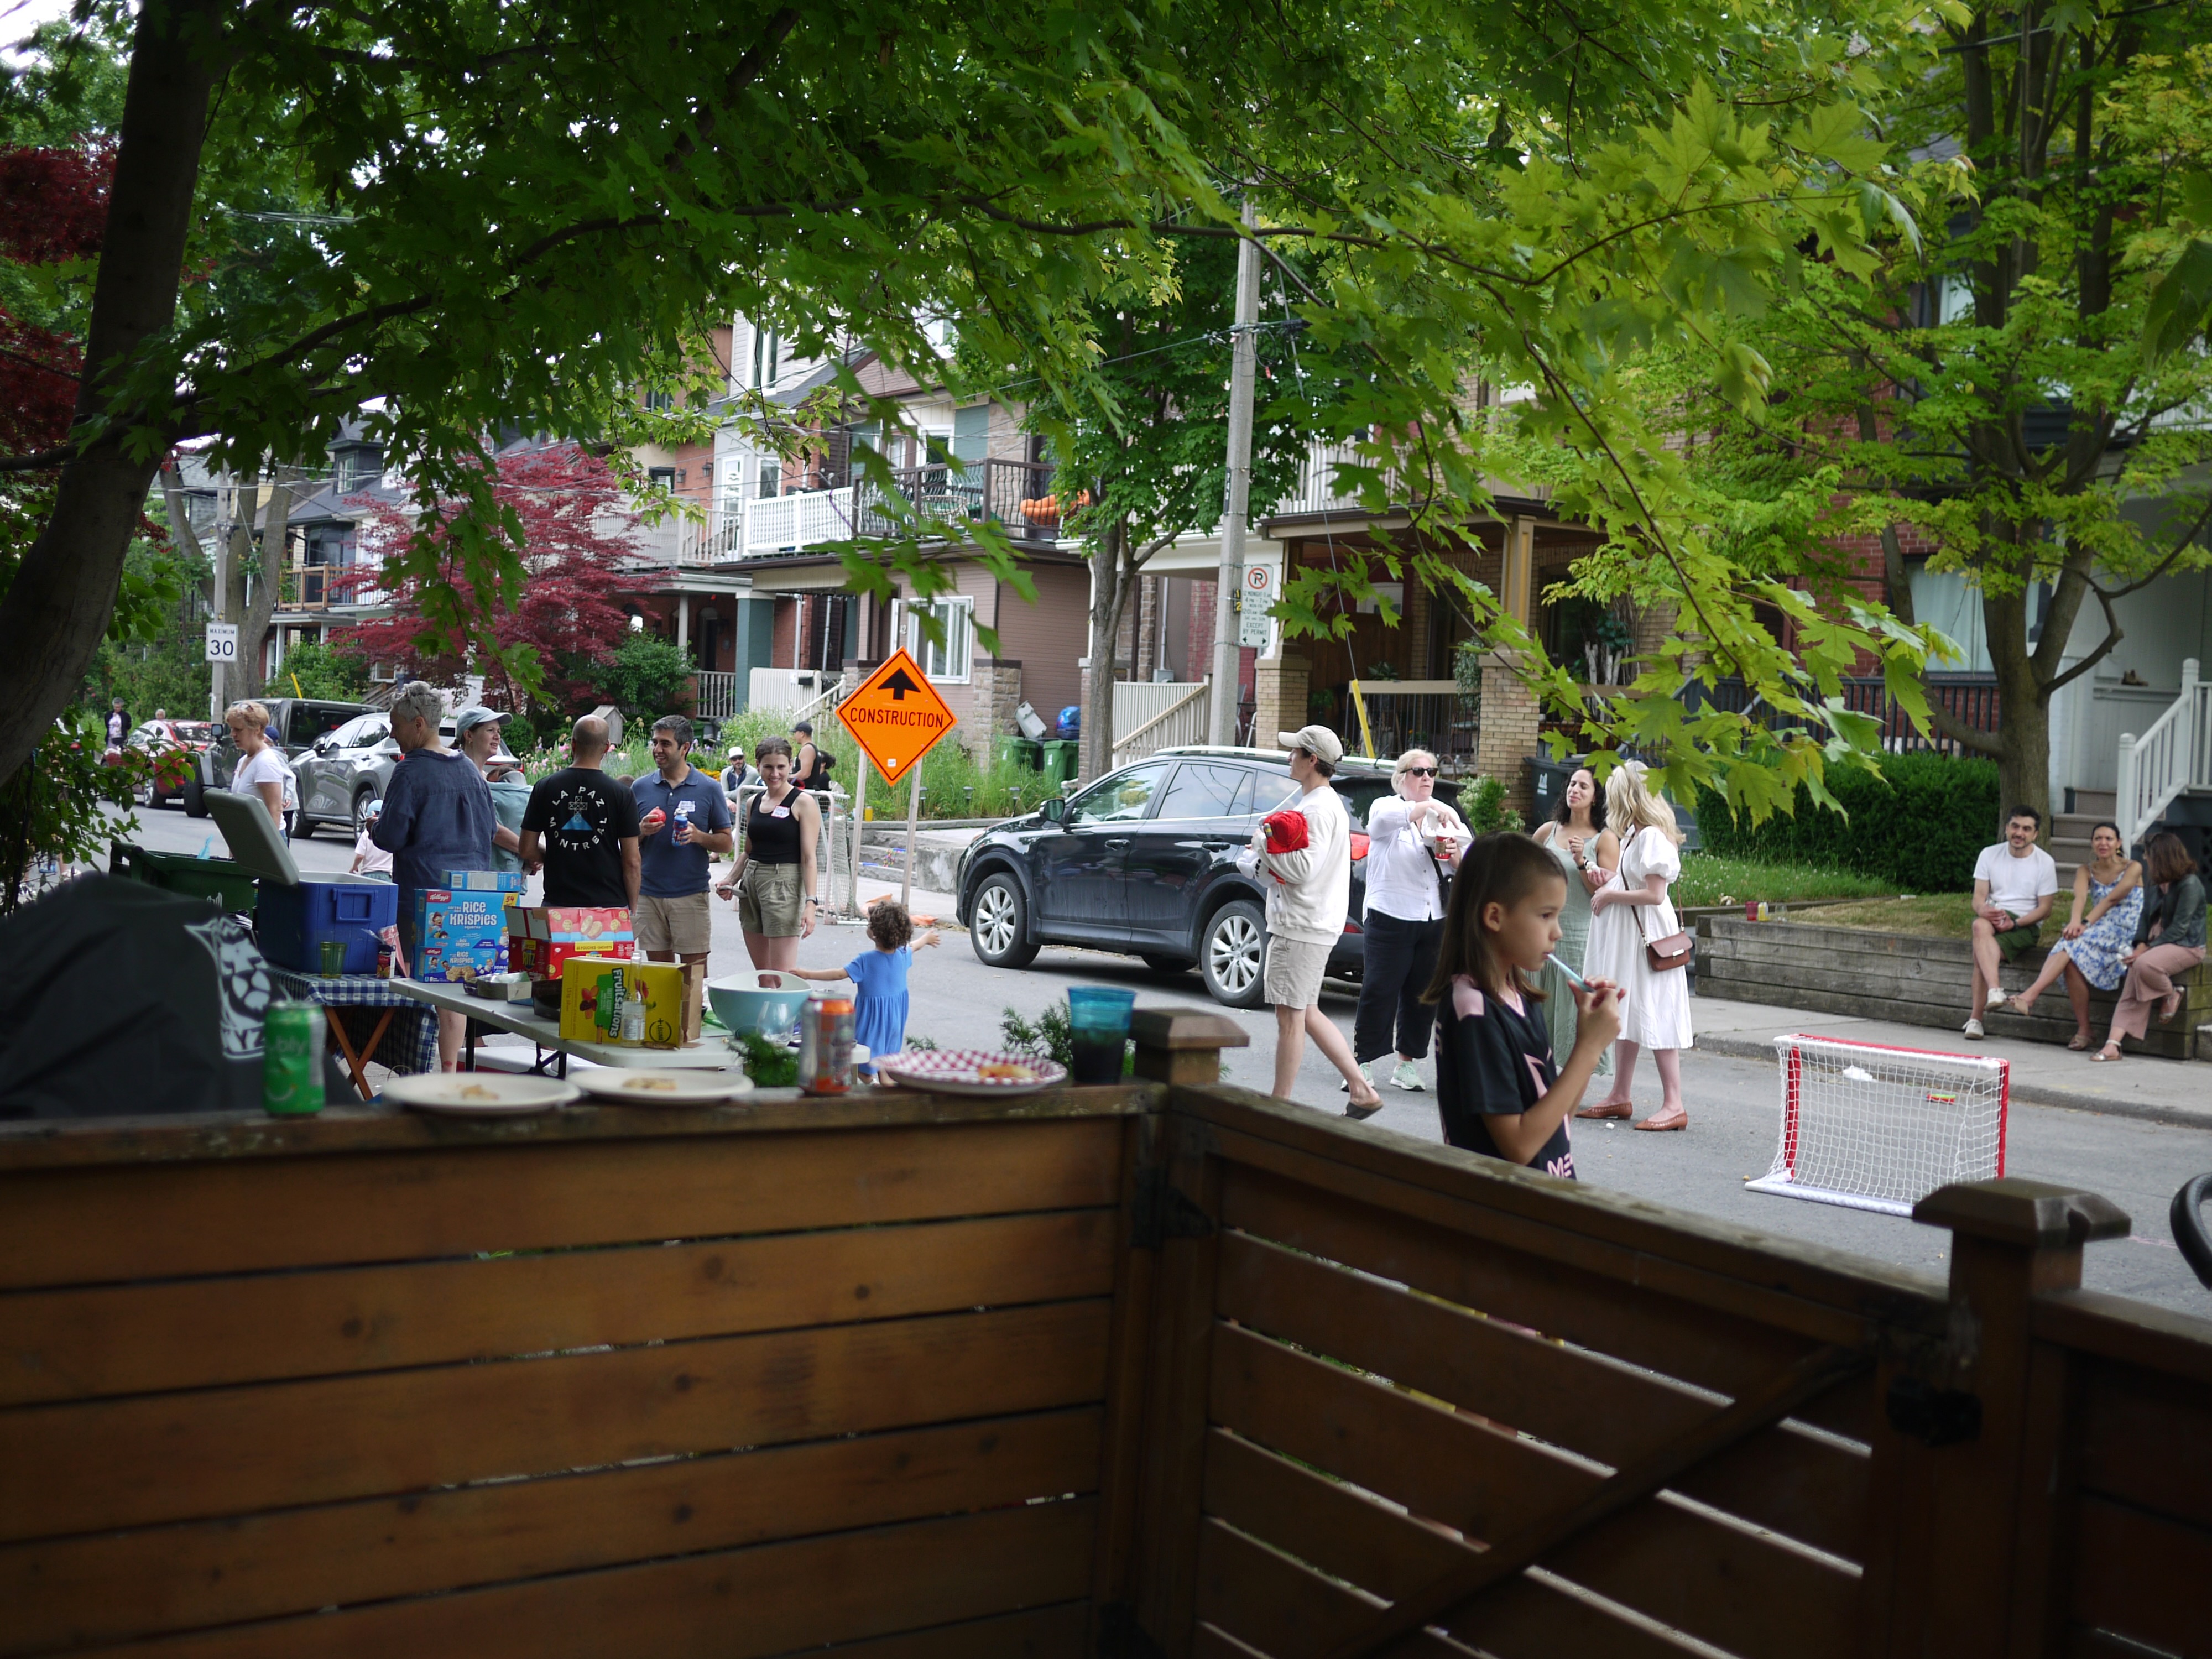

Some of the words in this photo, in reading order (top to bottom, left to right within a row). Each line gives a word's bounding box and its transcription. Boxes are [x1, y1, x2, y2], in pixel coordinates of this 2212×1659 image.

[210, 640, 233, 656] 30
[851, 707, 943, 728] CONSTRUCTION
[552, 790, 568, 806] LA
[578, 786, 605, 807] PAZ
[550, 816, 607, 851] MONTREAL
[430, 893, 449, 901] Kellogg's
[462, 901, 486, 913] Rice
[609, 969, 625, 1037] Fruitsations
